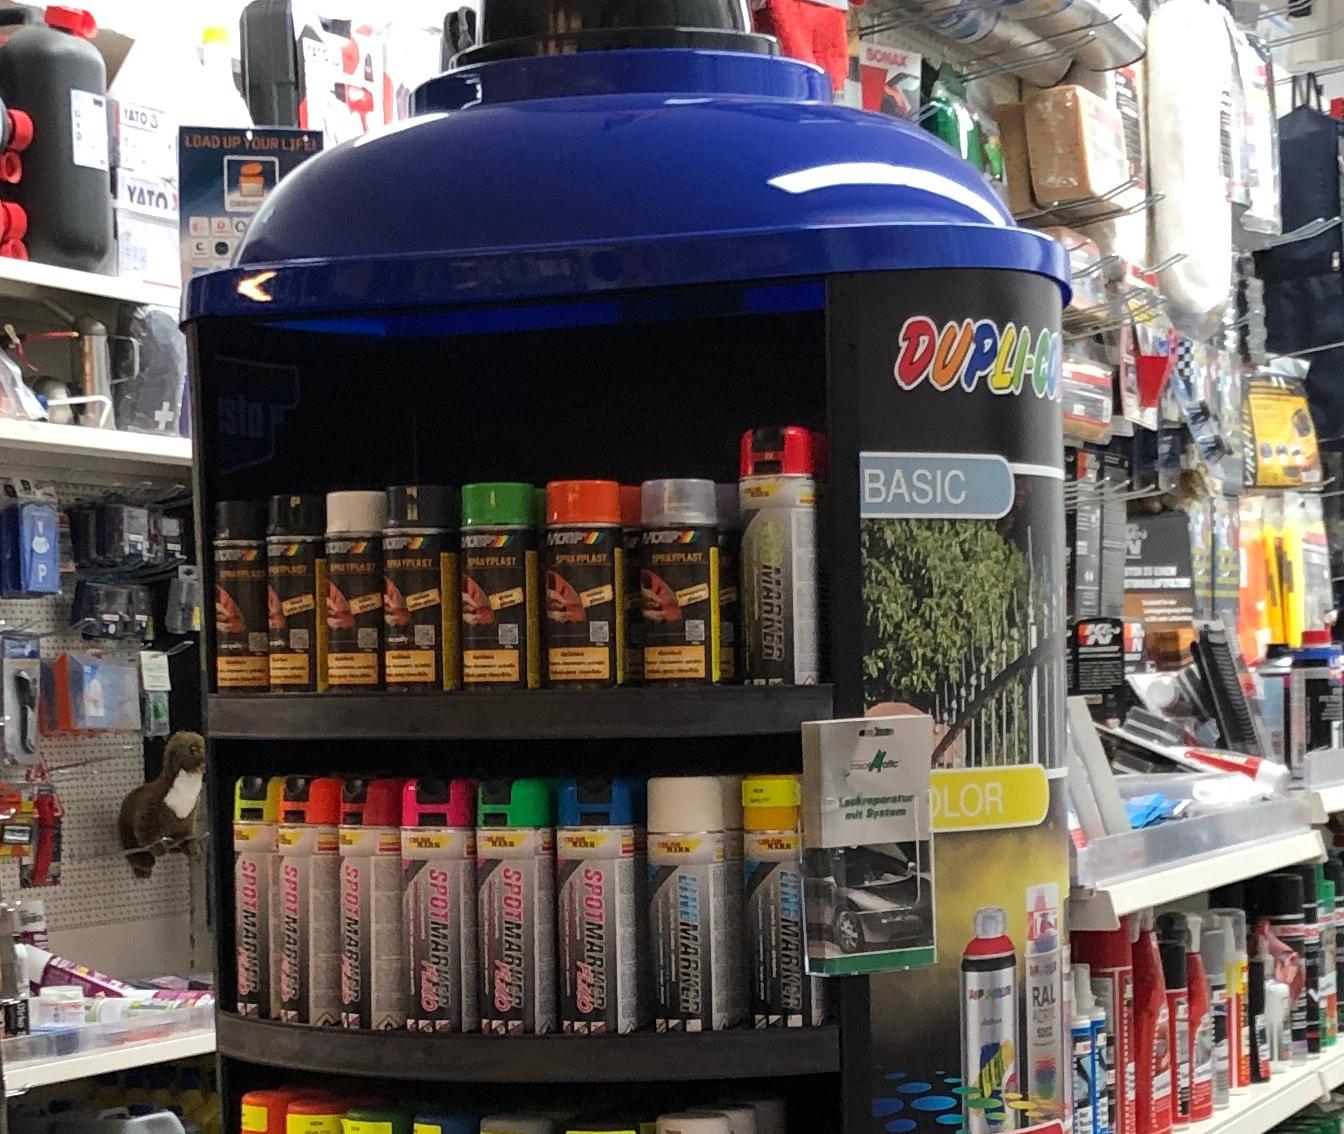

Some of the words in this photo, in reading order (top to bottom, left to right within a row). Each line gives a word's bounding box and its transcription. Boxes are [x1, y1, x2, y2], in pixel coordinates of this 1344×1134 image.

[865, 48, 908, 67] SONAX
[124, 108, 148, 124] YATO
[185, 135, 220, 148] LOAD
[224, 136, 241, 149] UP
[243, 137, 279, 150] YOUR
[127, 185, 168, 210] YATO
[863, 468, 966, 504] BASIC
[1086, 623, 1121, 645] K&N
[838, 793, 915, 808] Lackreparatur
[930, 782, 1004, 817] OLOR
[845, 810, 863, 820] mit
[866, 807, 906, 819] System
[1032, 985, 1056, 1007] RAL
